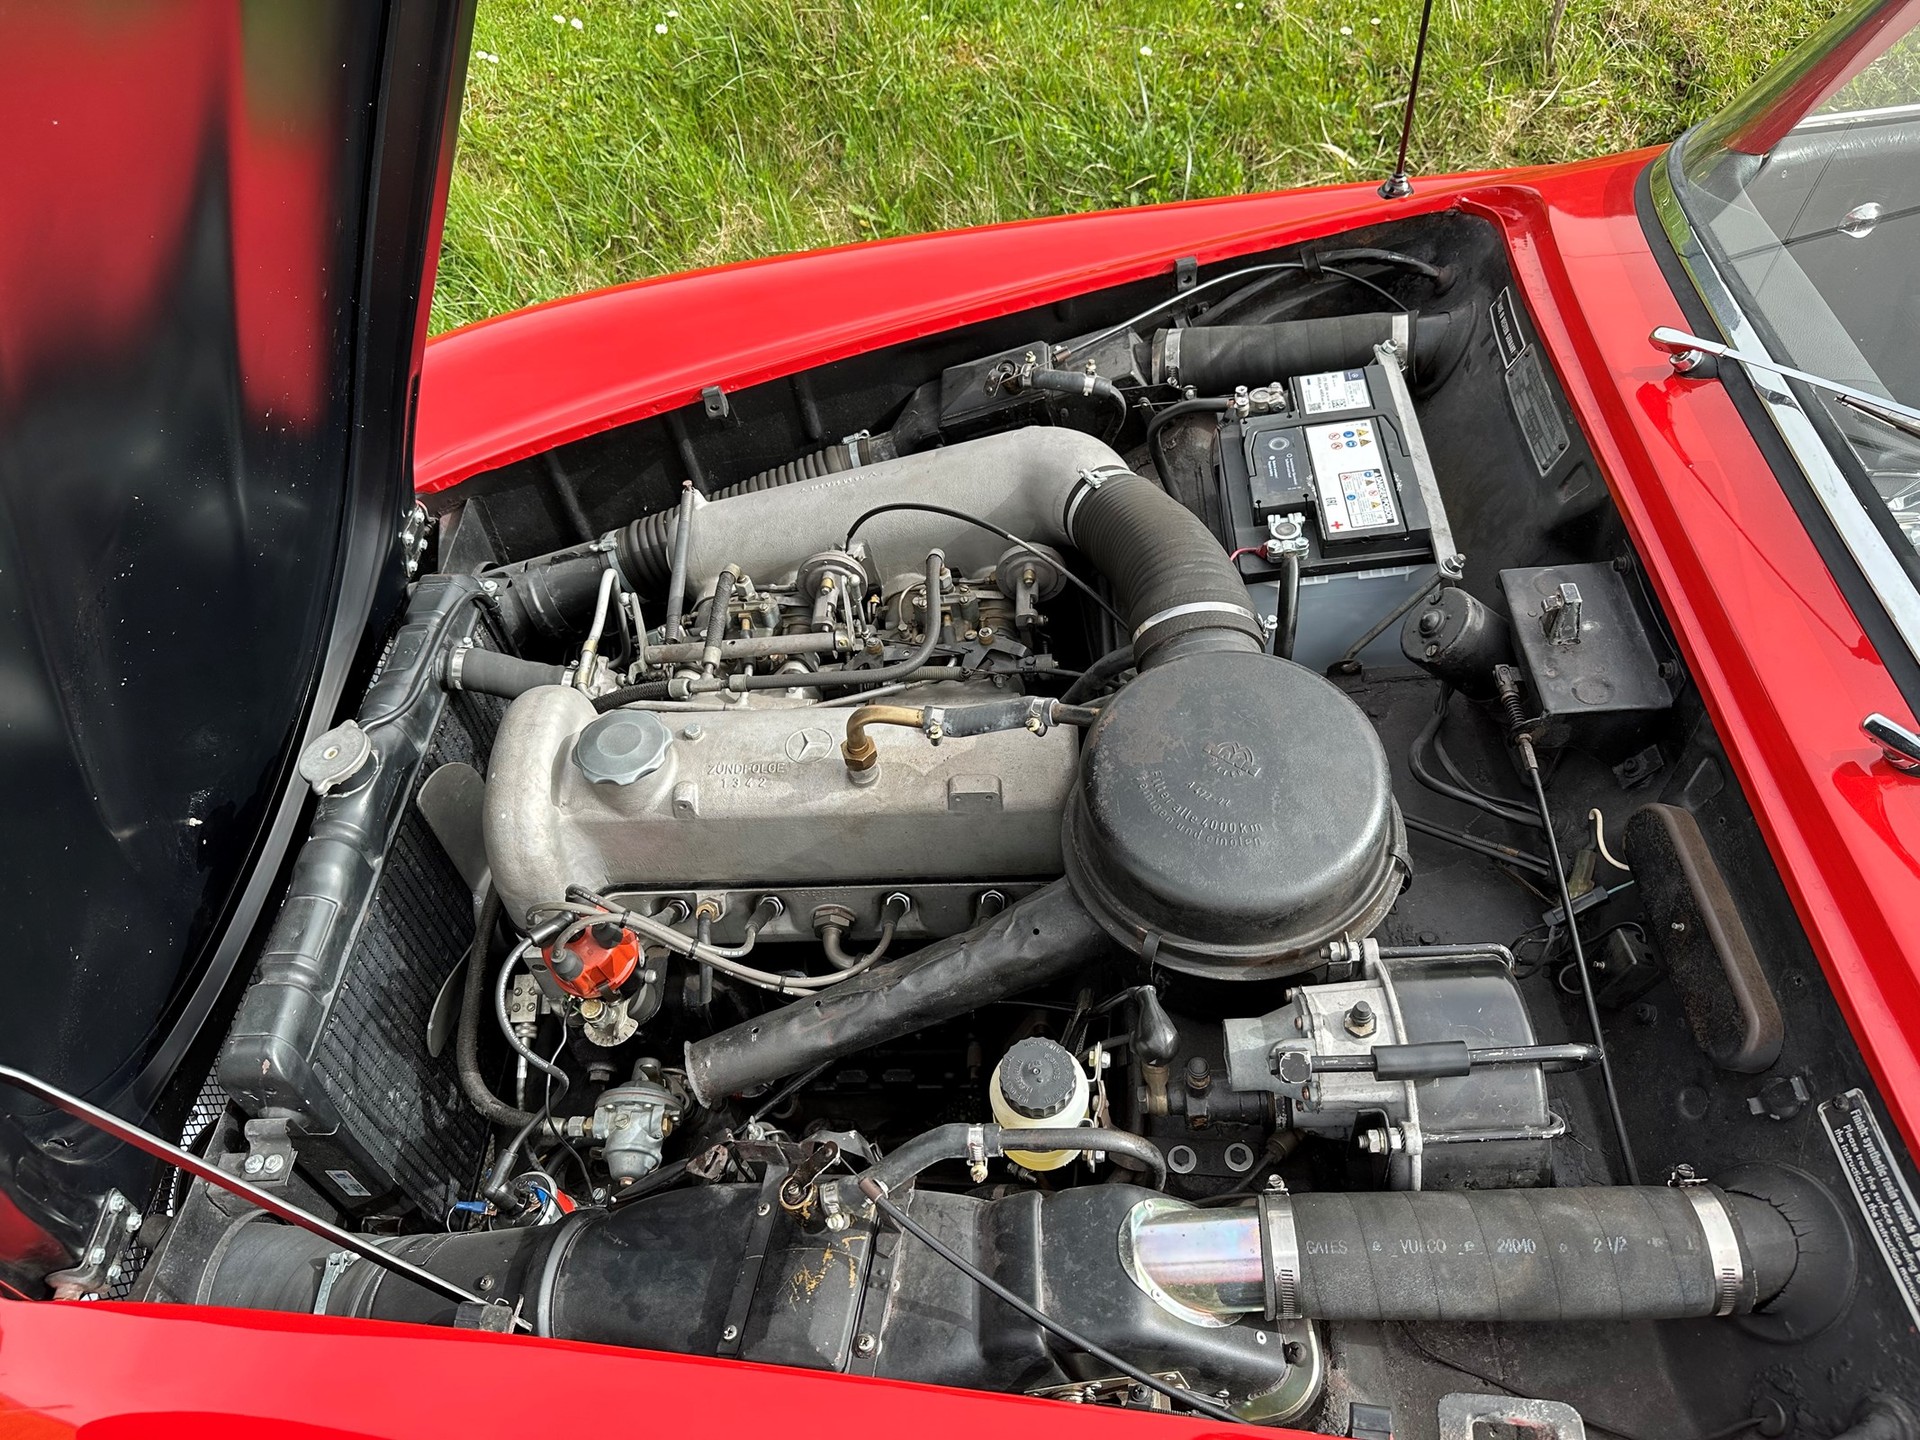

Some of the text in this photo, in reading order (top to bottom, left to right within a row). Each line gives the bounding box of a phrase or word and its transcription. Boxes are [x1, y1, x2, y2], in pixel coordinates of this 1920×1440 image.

[707, 761, 785, 776] ZÜNDFOLGE
[1172, 803, 1198, 824] alle
[1176, 822, 1203, 840] und
[1205, 833, 1262, 848] einölen
[1850, 1108, 1870, 1138] Finish:
[1862, 1136, 1888, 1178] synthetic
[1880, 1174, 1899, 1200] resin
[1892, 1200, 1918, 1234] varnish
[1834, 1128, 1844, 1143] the
[1840, 1144, 1866, 1191] instructions
[1862, 1192, 1872, 1202] in
[1868, 1202, 1879, 1218] the
[1874, 1218, 1902, 1266] instruction
[1843, 1124, 1860, 1153] Please
[1856, 1153, 1870, 1175] treat
[1866, 1175, 1877, 1190] the
[1873, 1192, 1894, 1225] surface
[1890, 1226, 1918, 1273] according
[1305, 1240, 1348, 1255] GATES
